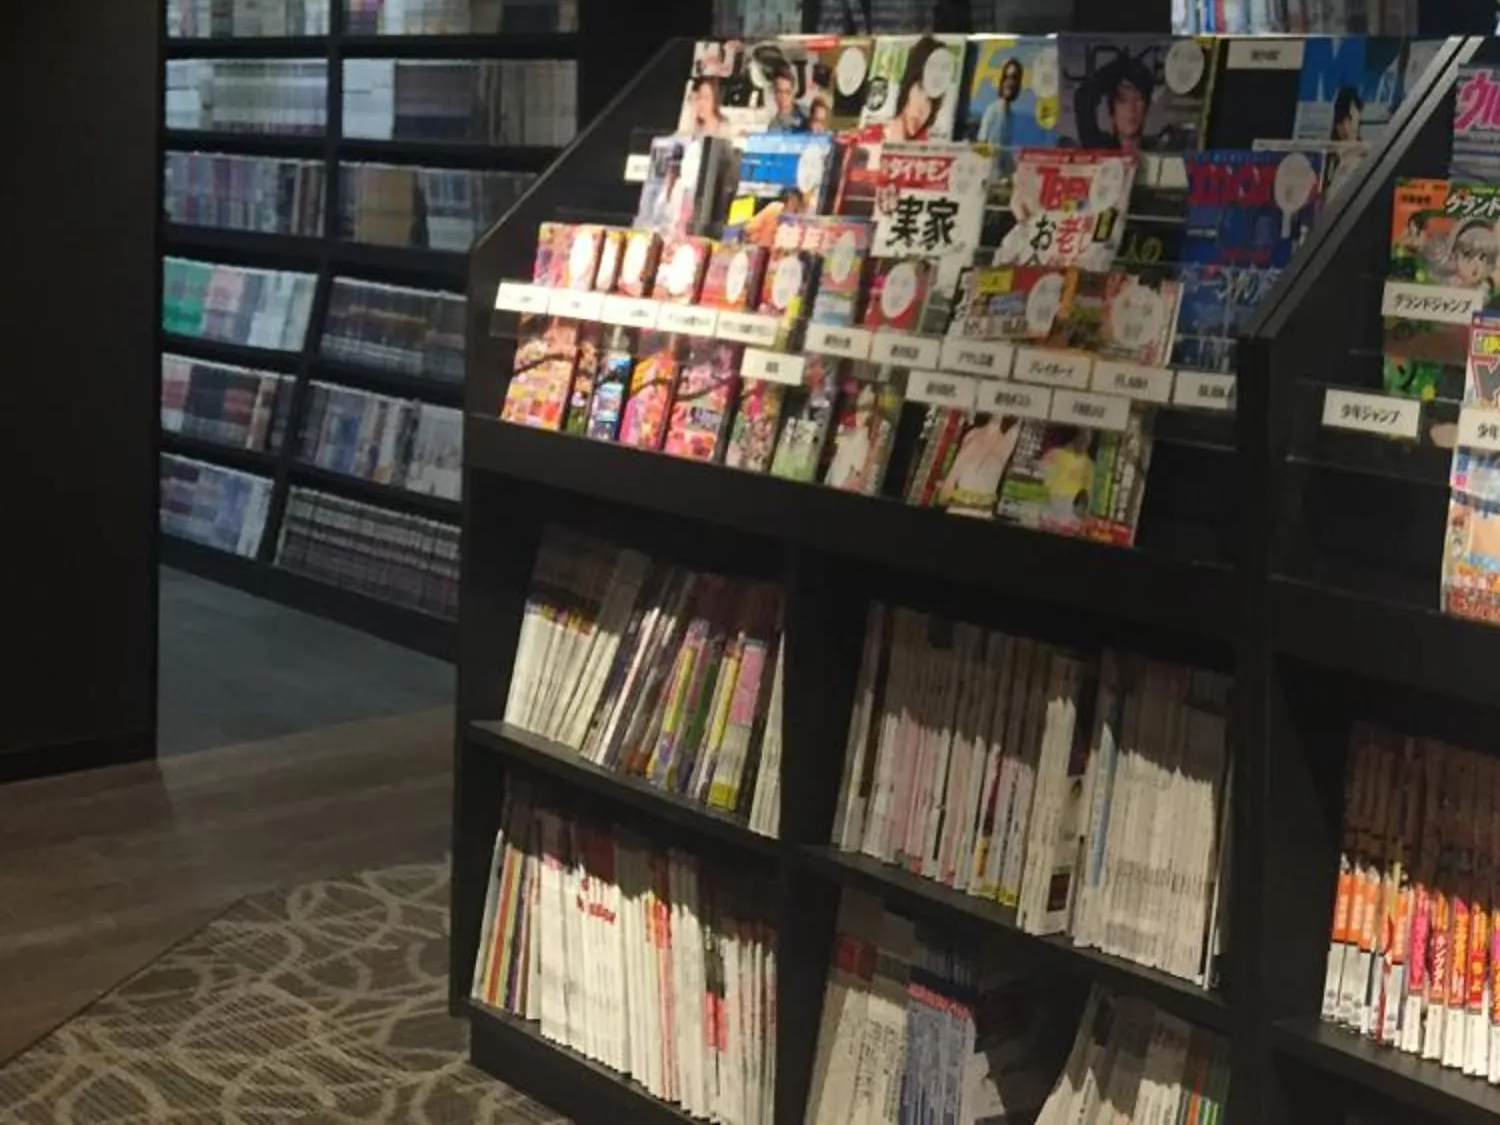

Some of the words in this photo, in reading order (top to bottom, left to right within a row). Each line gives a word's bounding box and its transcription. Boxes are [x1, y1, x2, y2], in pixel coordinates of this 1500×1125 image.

[887, 196, 959, 250] 実家
[1394, 292, 1473, 314] グランドジャンプ
[1340, 402, 1402, 425] 少年ジャンプ
